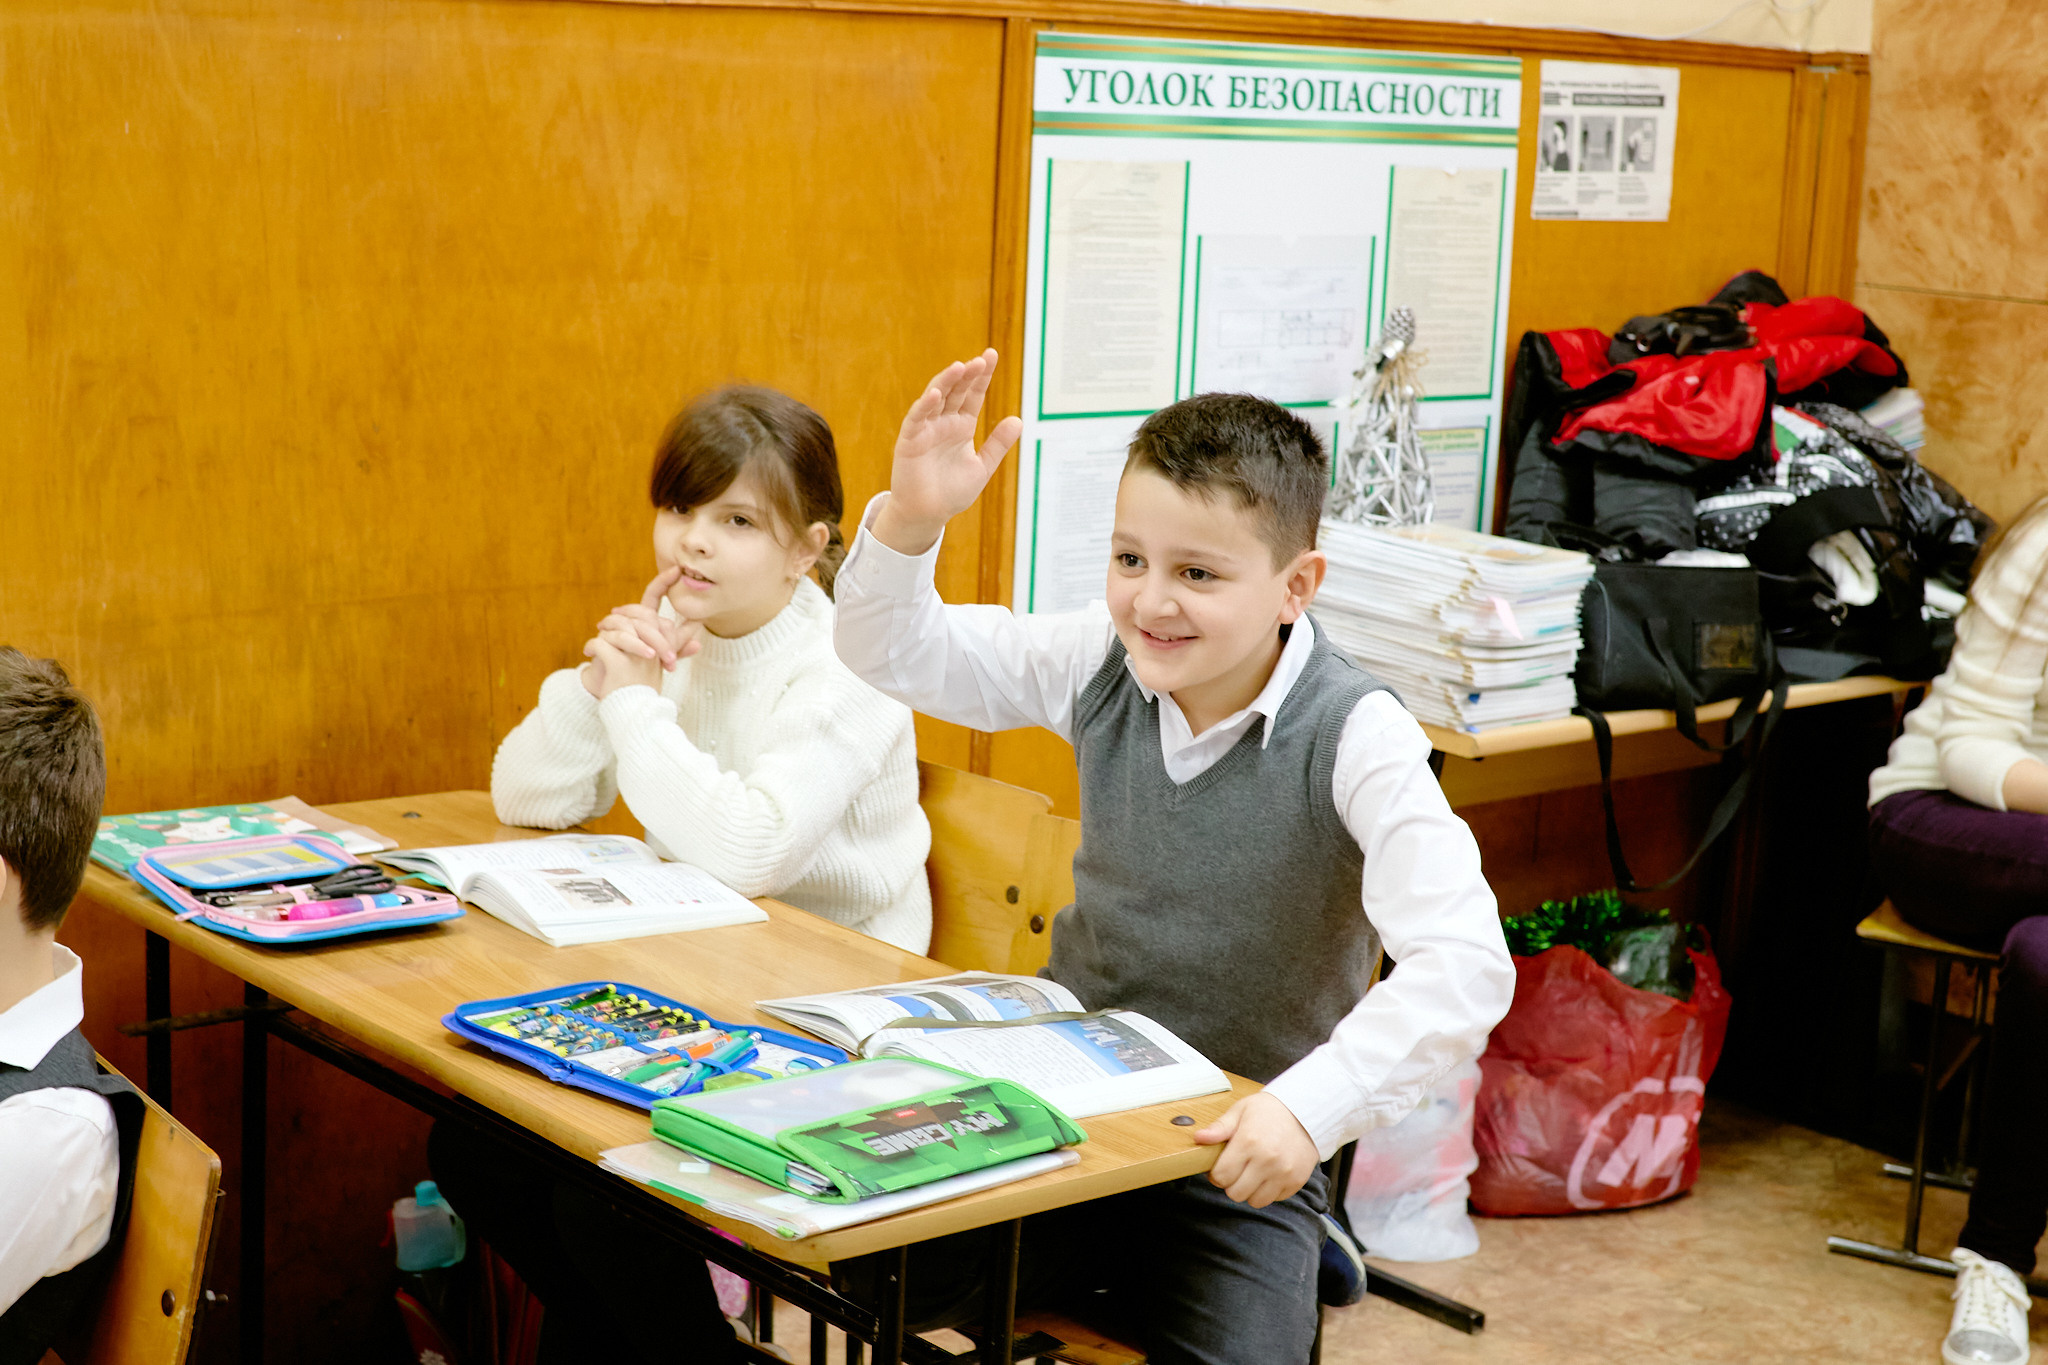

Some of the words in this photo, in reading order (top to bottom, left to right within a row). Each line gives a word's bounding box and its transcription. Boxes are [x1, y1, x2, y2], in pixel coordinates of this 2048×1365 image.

[1062, 68, 1214, 108] УГОЛОК
[1227, 75, 1501, 118] БЕЗОПАСНОСТИ
[949, 1111, 1005, 1135] MY
